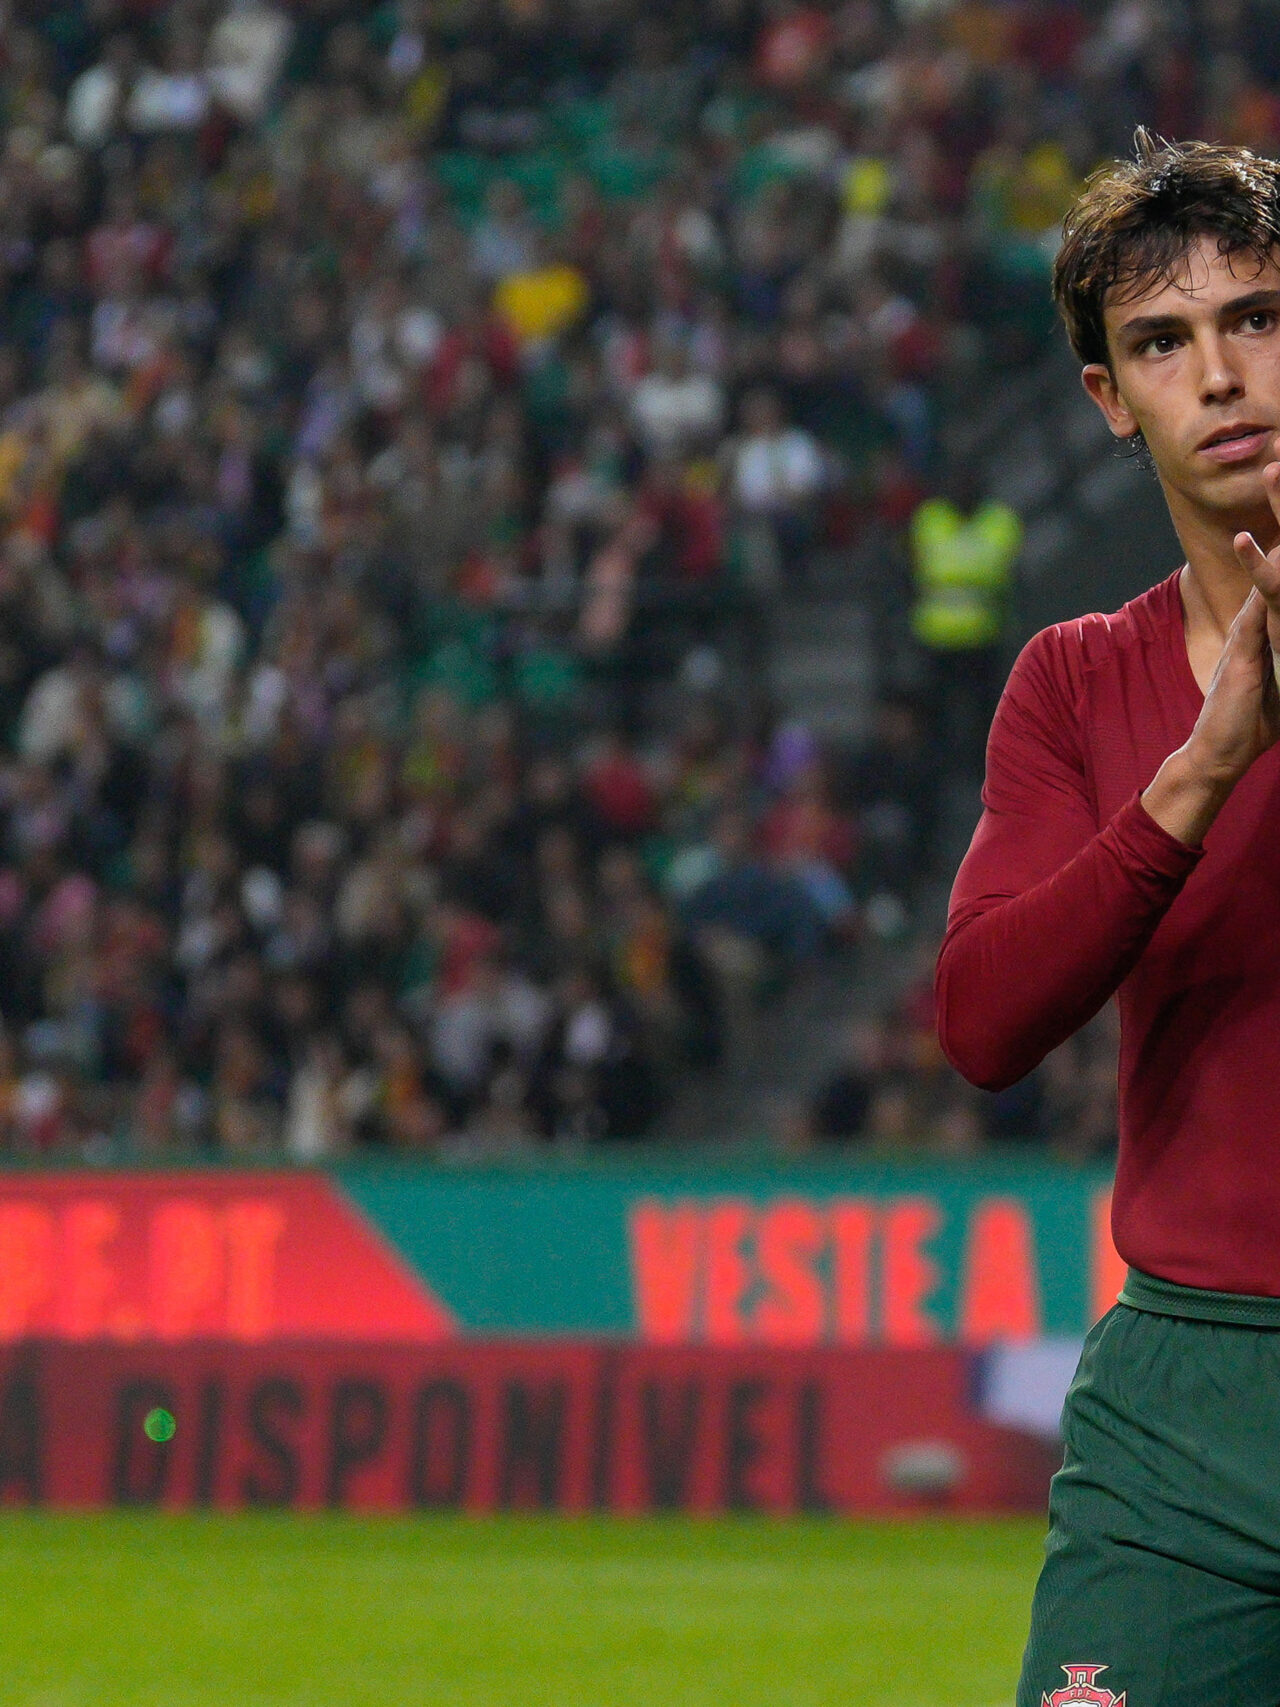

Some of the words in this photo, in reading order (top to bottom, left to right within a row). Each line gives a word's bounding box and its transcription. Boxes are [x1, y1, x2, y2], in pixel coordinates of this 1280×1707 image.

[630, 1197, 942, 1345] VESTE
[956, 1198, 1042, 1344] A
[112, 1345, 834, 1512] DISPONÍVEL
